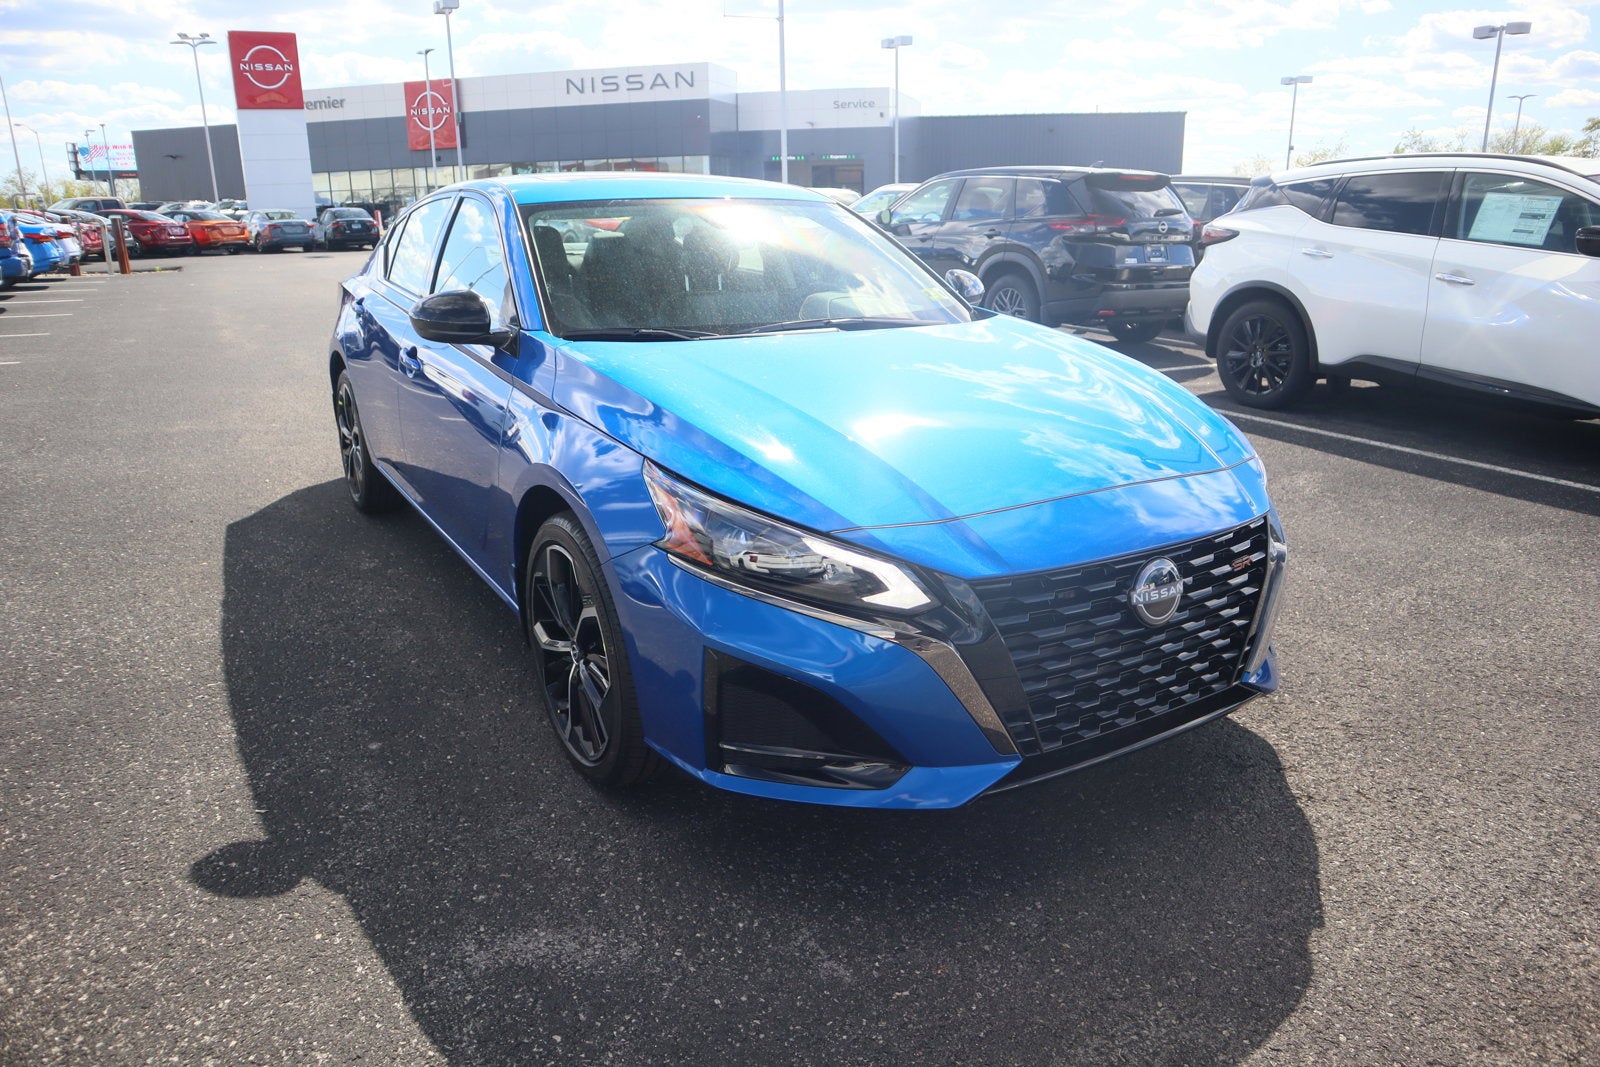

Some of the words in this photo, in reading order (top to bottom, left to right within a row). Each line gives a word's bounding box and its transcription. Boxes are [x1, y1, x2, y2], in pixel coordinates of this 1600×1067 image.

[240, 63, 293, 71] NISSAN
[565, 71, 695, 95] NISSAN
[304, 95, 346, 111] emier
[833, 99, 876, 110] Service
[1231, 555, 1253, 572] SR
[1133, 580, 1184, 603] NISSAN
